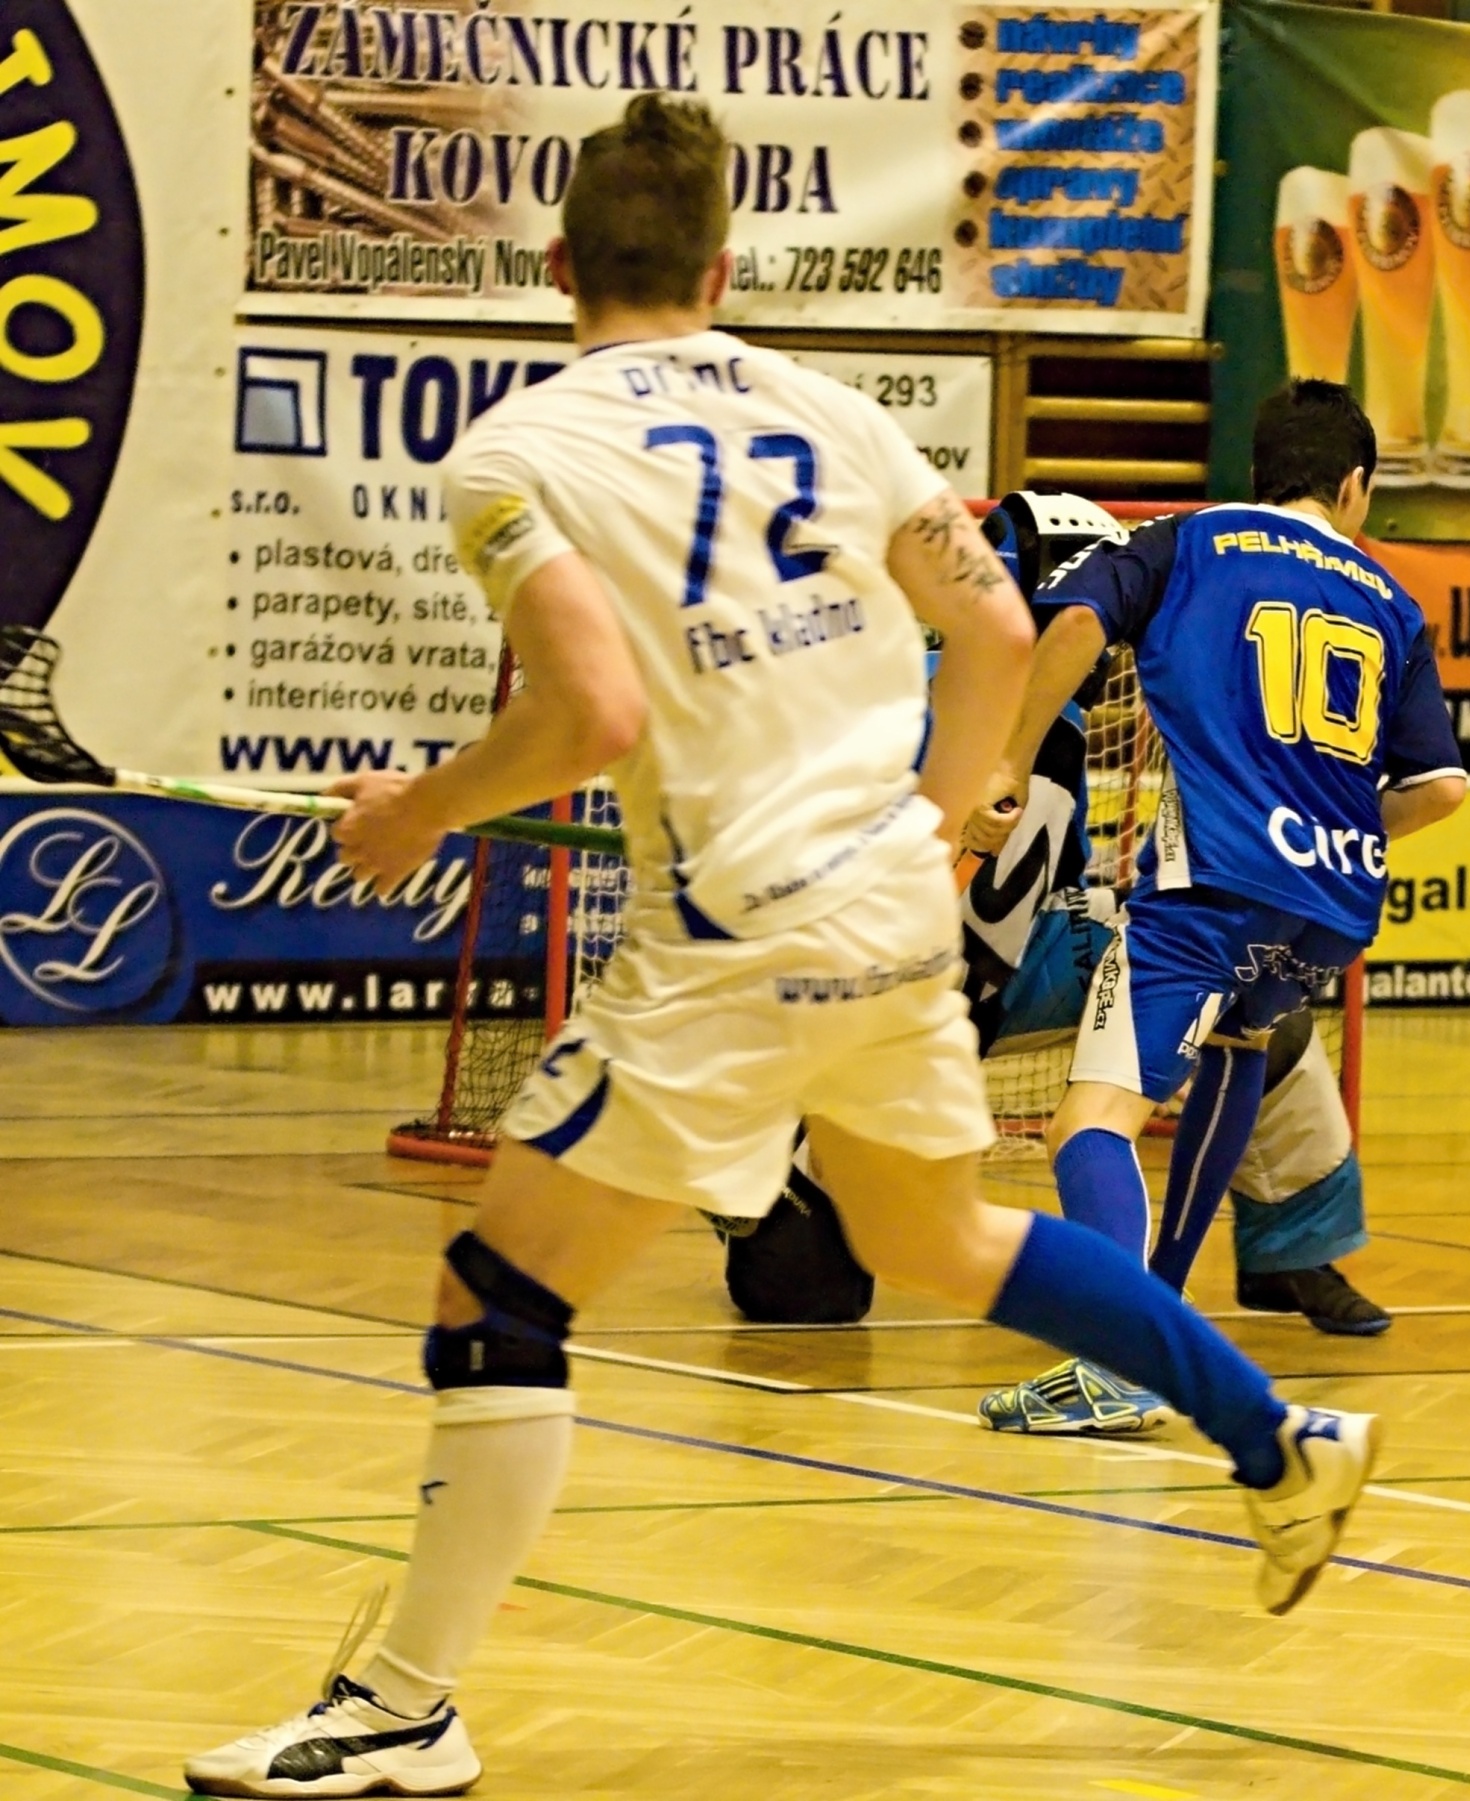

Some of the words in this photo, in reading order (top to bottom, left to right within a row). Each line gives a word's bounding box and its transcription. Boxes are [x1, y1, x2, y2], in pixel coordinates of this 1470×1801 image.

[722, 10, 929, 100] PRÁCE
[258, 231, 329, 278] Pavel
[338, 233, 485, 290] Vopálenský
[785, 247, 836, 292] 723
[839, 248, 889, 292] 592
[894, 249, 942, 293] 646
[877, 374, 938, 407] 293
[231, 488, 299, 514] s.r.o.
[353, 484, 447, 522] OKN
[644, 425, 841, 608] 72
[254, 540, 403, 576] plastová,
[252, 590, 400, 625] parapety,
[413, 592, 477, 624] sítě,
[250, 635, 395, 669] garážová
[408, 641, 497, 673] vrata,
[248, 681, 417, 714] interiérové
[1245, 601, 1386, 766] 10
